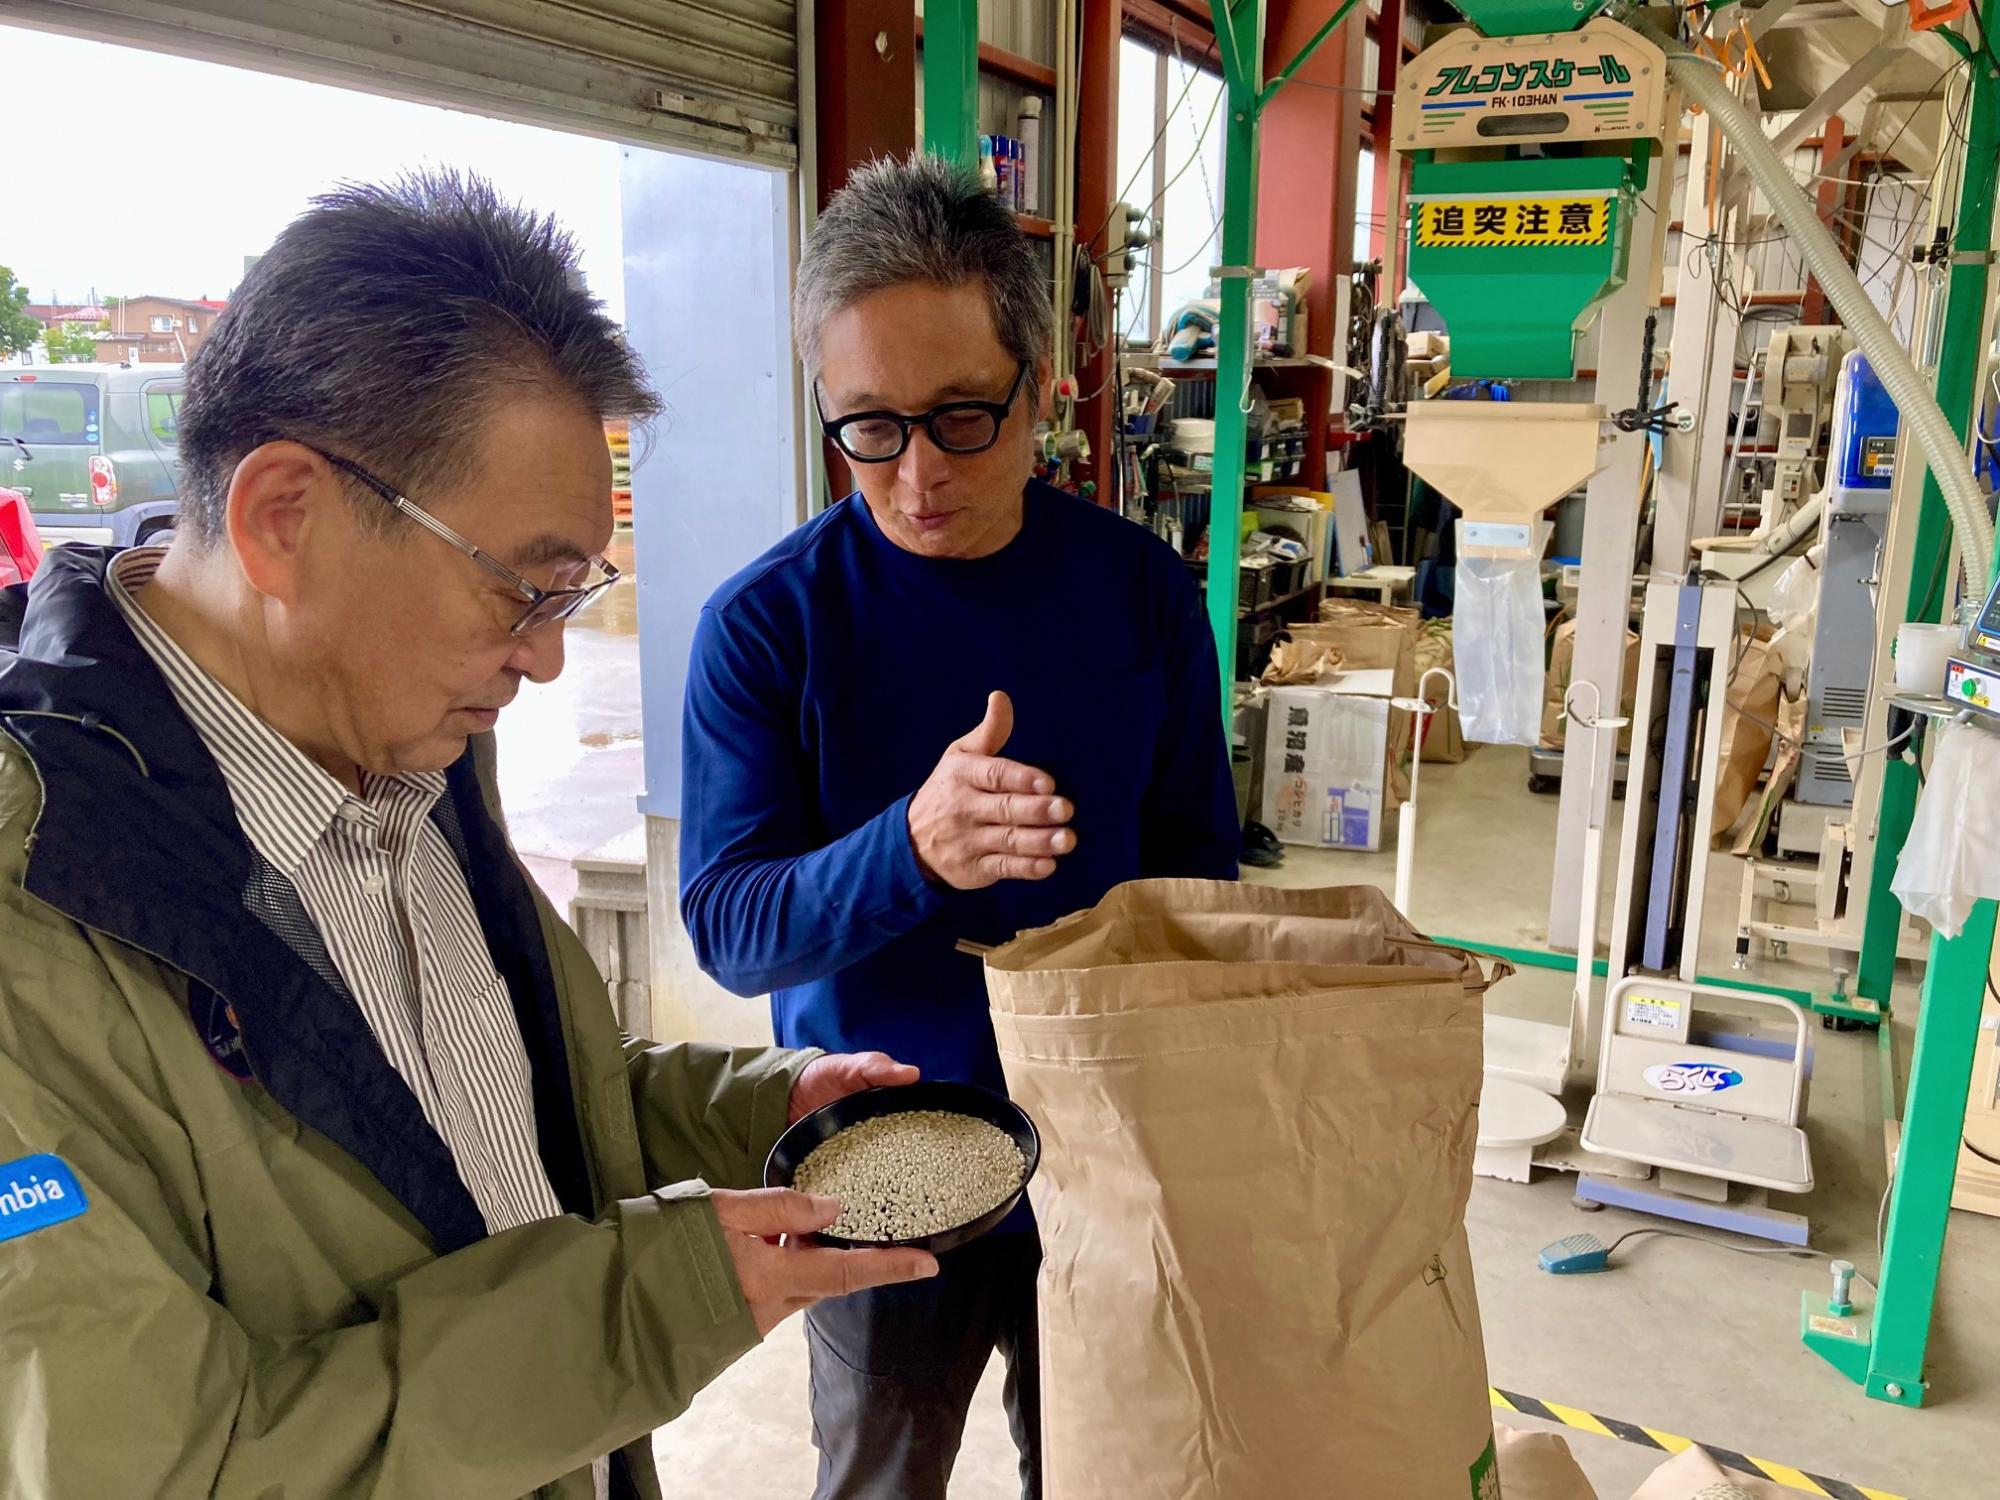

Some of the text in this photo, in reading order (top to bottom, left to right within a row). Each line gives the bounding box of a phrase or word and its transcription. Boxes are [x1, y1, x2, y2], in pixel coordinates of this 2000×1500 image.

[1424, 54, 1631, 97] フレコンスケール
[1432, 203, 1593, 236] 追突注意
